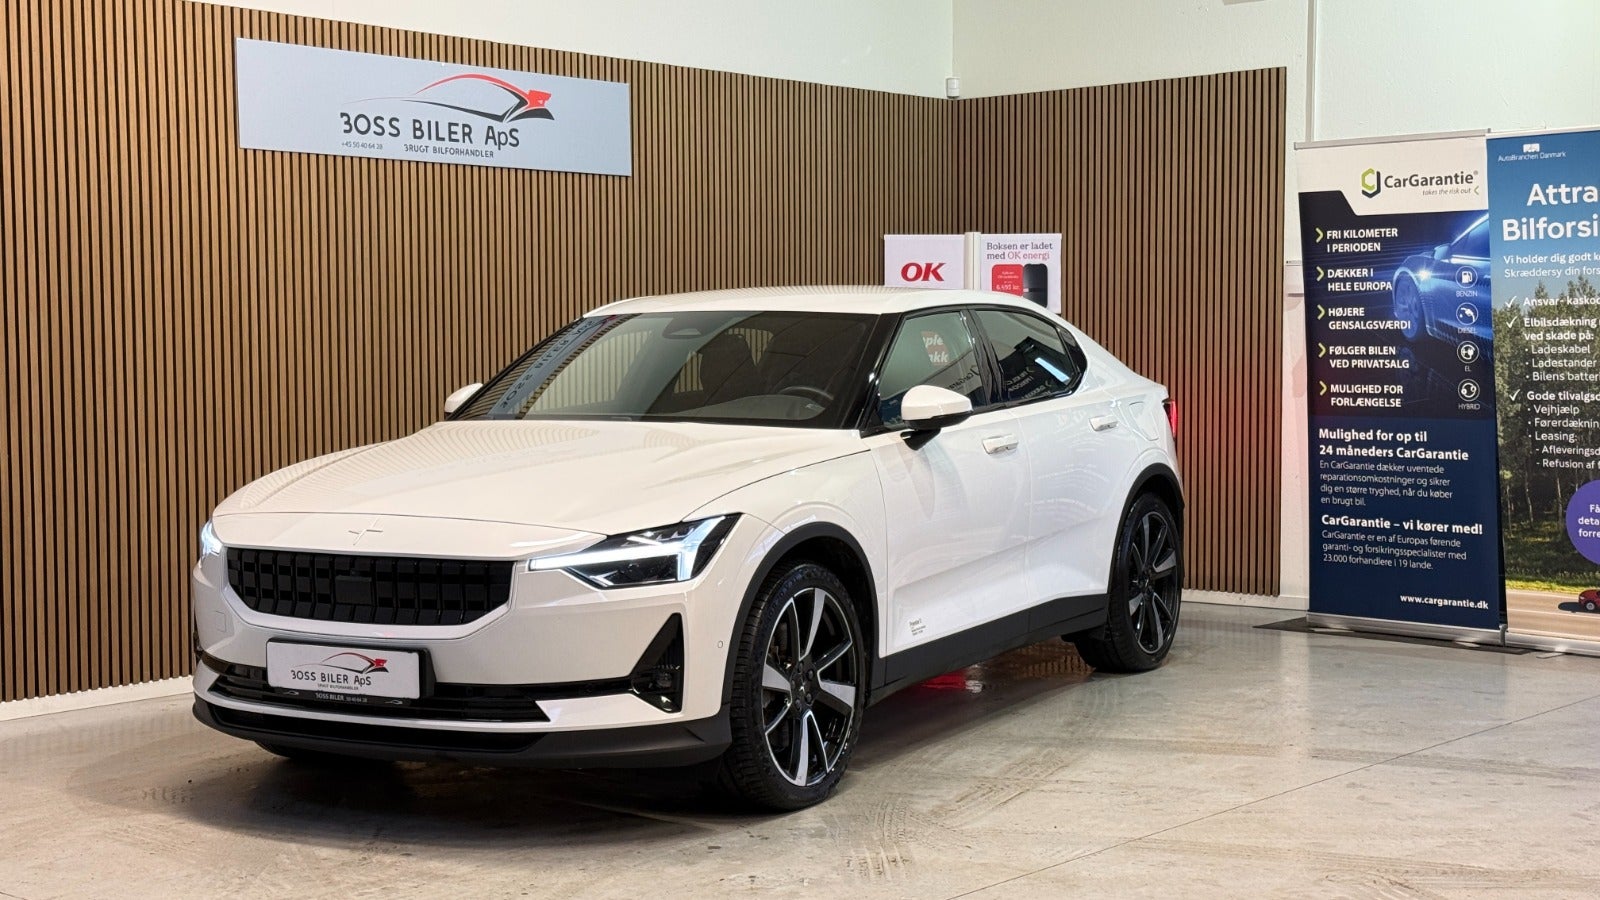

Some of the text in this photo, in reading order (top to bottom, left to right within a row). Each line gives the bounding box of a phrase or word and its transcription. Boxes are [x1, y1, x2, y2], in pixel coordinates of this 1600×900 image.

[413, 119, 473, 144] BILER
[485, 125, 519, 150] ApS
[433, 146, 494, 158] BILFORHANDLER
[1526, 184, 1598, 206] Attra
[1502, 213, 1598, 241] Bilforsi
[1327, 228, 1398, 240] FRI KILOMETER
[987, 242, 1018, 250] Boksen
[1031, 242, 1053, 250] ladet
[1332, 242, 1380, 252] PERIODEN
[1008, 251, 1021, 259] OK
[1023, 252, 1050, 261] energi
[1503, 255, 1514, 264] Vi
[1516, 254, 1548, 264] holder
[1551, 253, 1566, 264] dig
[1568, 253, 1592, 264] godt
[900, 262, 946, 282] OK
[1328, 269, 1368, 278] DÆKKER
[1504, 266, 1600, 278] Skræddersy din fors
[1328, 282, 1392, 291] HELE EUROPA
[1523, 297, 1564, 306] Ansvar-
[1328, 307, 1365, 317] HØJERE
[1328, 320, 1411, 330] GENSALGSVÆRDI
[1524, 317, 1597, 328] Elbilsdækning
[923, 334, 944, 348] ple
[1524, 330, 1594, 342] ved skade på:
[1329, 345, 1396, 356] FØLGER BILEN
[1531, 344, 1590, 354] Ladeskabel
[1330, 359, 1409, 369] VED PRIVATSALG
[1532, 358, 1597, 367] Ladestander
[1532, 372, 1565, 380] Bilens
[1330, 384, 1403, 394] MULIGHED FOR
[1527, 391, 1555, 401] Gode
[1331, 398, 1402, 407] FORLÆNGELSE
[1534, 404, 1579, 416] Vejhjælp
[1319, 428, 1428, 445] Mulighed for op til
[1535, 431, 1577, 443] Leasing:
[1320, 444, 1469, 460] 24 måneders CarGarantie
[1320, 460, 1444, 474] En CarGarantie dækker uventede
[1542, 459, 1584, 468] Refusion
[1586, 460, 1595, 469] af
[1320, 474, 1451, 487] reparationsomkostninger og sikrer
[1321, 484, 1332, 494] dig
[1346, 486, 1367, 494] større
[1369, 487, 1401, 497] tryghed,
[1403, 487, 1415, 496] når
[1417, 489, 1428, 497] du
[1429, 490, 1452, 498] køber
[1332, 496, 1353, 507] brugt
[1355, 497, 1366, 506] bil.
[1322, 515, 1391, 529] CarGarantie
[1403, 520, 1414, 530] vi
[1417, 520, 1449, 533] kører
[1452, 524, 1483, 535] med!
[1578, 516, 1600, 525] deta
[1322, 530, 1366, 540] CarGarantie
[1389, 535, 1396, 543] af
[1398, 535, 1428, 546] Europas
[1430, 537, 1461, 547] førende
[1579, 529, 1600, 537] forre
[1323, 544, 1467, 560] garanti- og forsikringsspecialister med
[1323, 554, 1348, 563] 23.000
[1349, 555, 1392, 566] forhandlere
[1399, 559, 1408, 567] 19
[1409, 559, 1433, 569] lande.
[1400, 594, 1489, 610] www.cargarantie.dk
[321, 673, 349, 684] BILER
[354, 675, 372, 687] ApS
